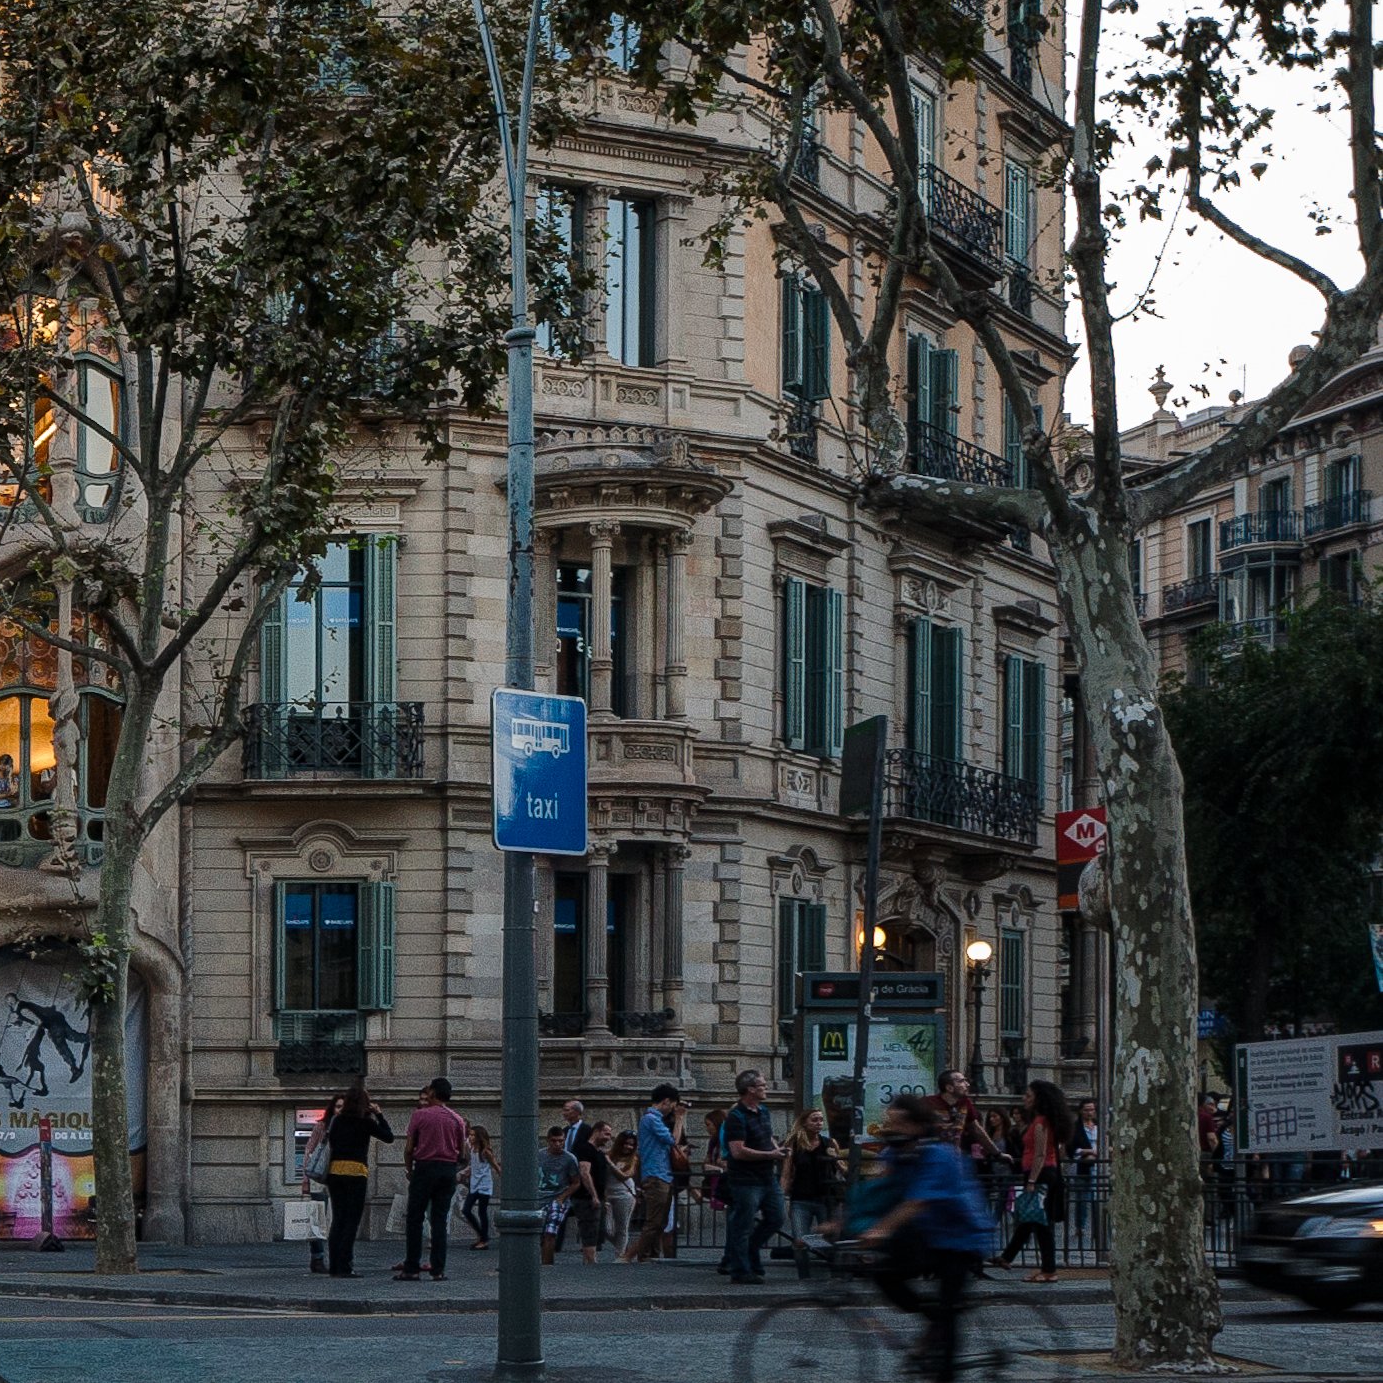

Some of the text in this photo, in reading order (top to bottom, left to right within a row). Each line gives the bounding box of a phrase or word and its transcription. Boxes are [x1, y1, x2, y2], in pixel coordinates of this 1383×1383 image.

[526, 791, 558, 820] taxi
[1076, 822, 1095, 839] M
[881, 984, 894, 994] de
[55, 1131, 67, 1140] DG
[69, 1131, 77, 1140] A
